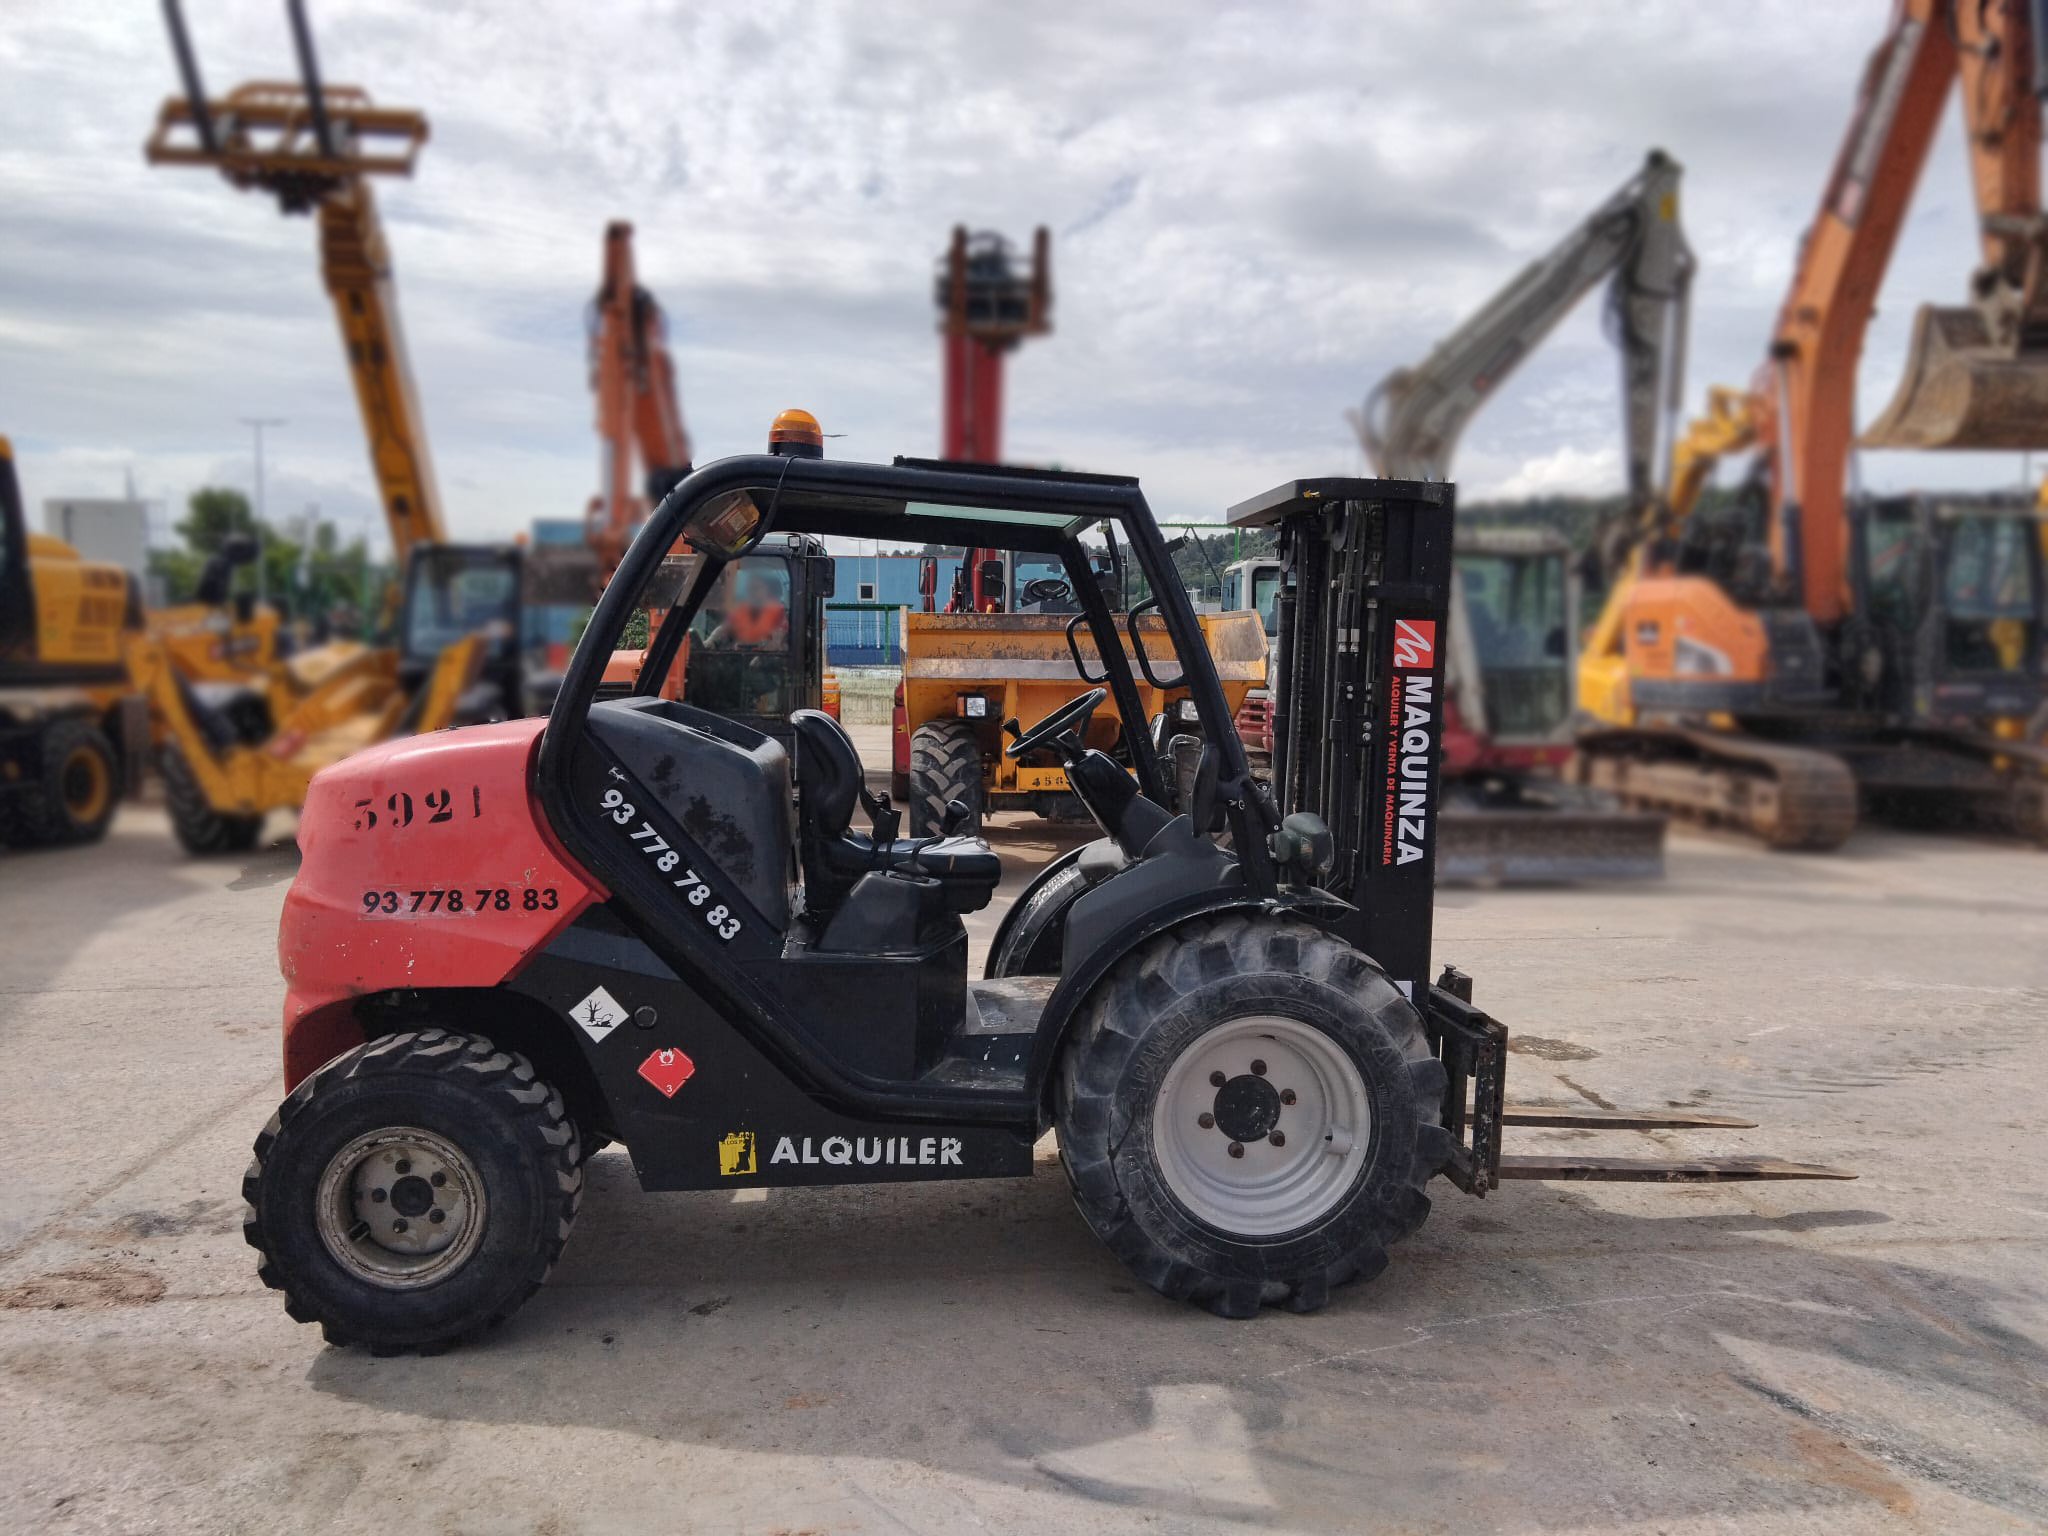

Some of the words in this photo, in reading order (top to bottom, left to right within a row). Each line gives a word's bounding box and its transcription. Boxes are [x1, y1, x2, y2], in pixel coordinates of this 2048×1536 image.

[1389, 676, 1401, 727] ALQUILER
[1388, 729, 1399, 737] Y
[1386, 739, 1398, 775] VENTA
[1396, 675, 1433, 866] MAQUINZA
[1386, 777, 1397, 791] DE
[1383, 794, 1396, 866] MAQUINARIA
[600, 789, 636, 825] 93
[629, 821, 680, 872] 778
[673, 868, 711, 906] 78
[706, 904, 741, 940] 83
[362, 890, 399, 914] 93
[409, 889, 465, 913] 778
[474, 888, 511, 912] 78
[522, 887, 560, 911] 83
[666, 1084, 673, 1093] 3
[769, 1135, 964, 1165] ALQUILER
